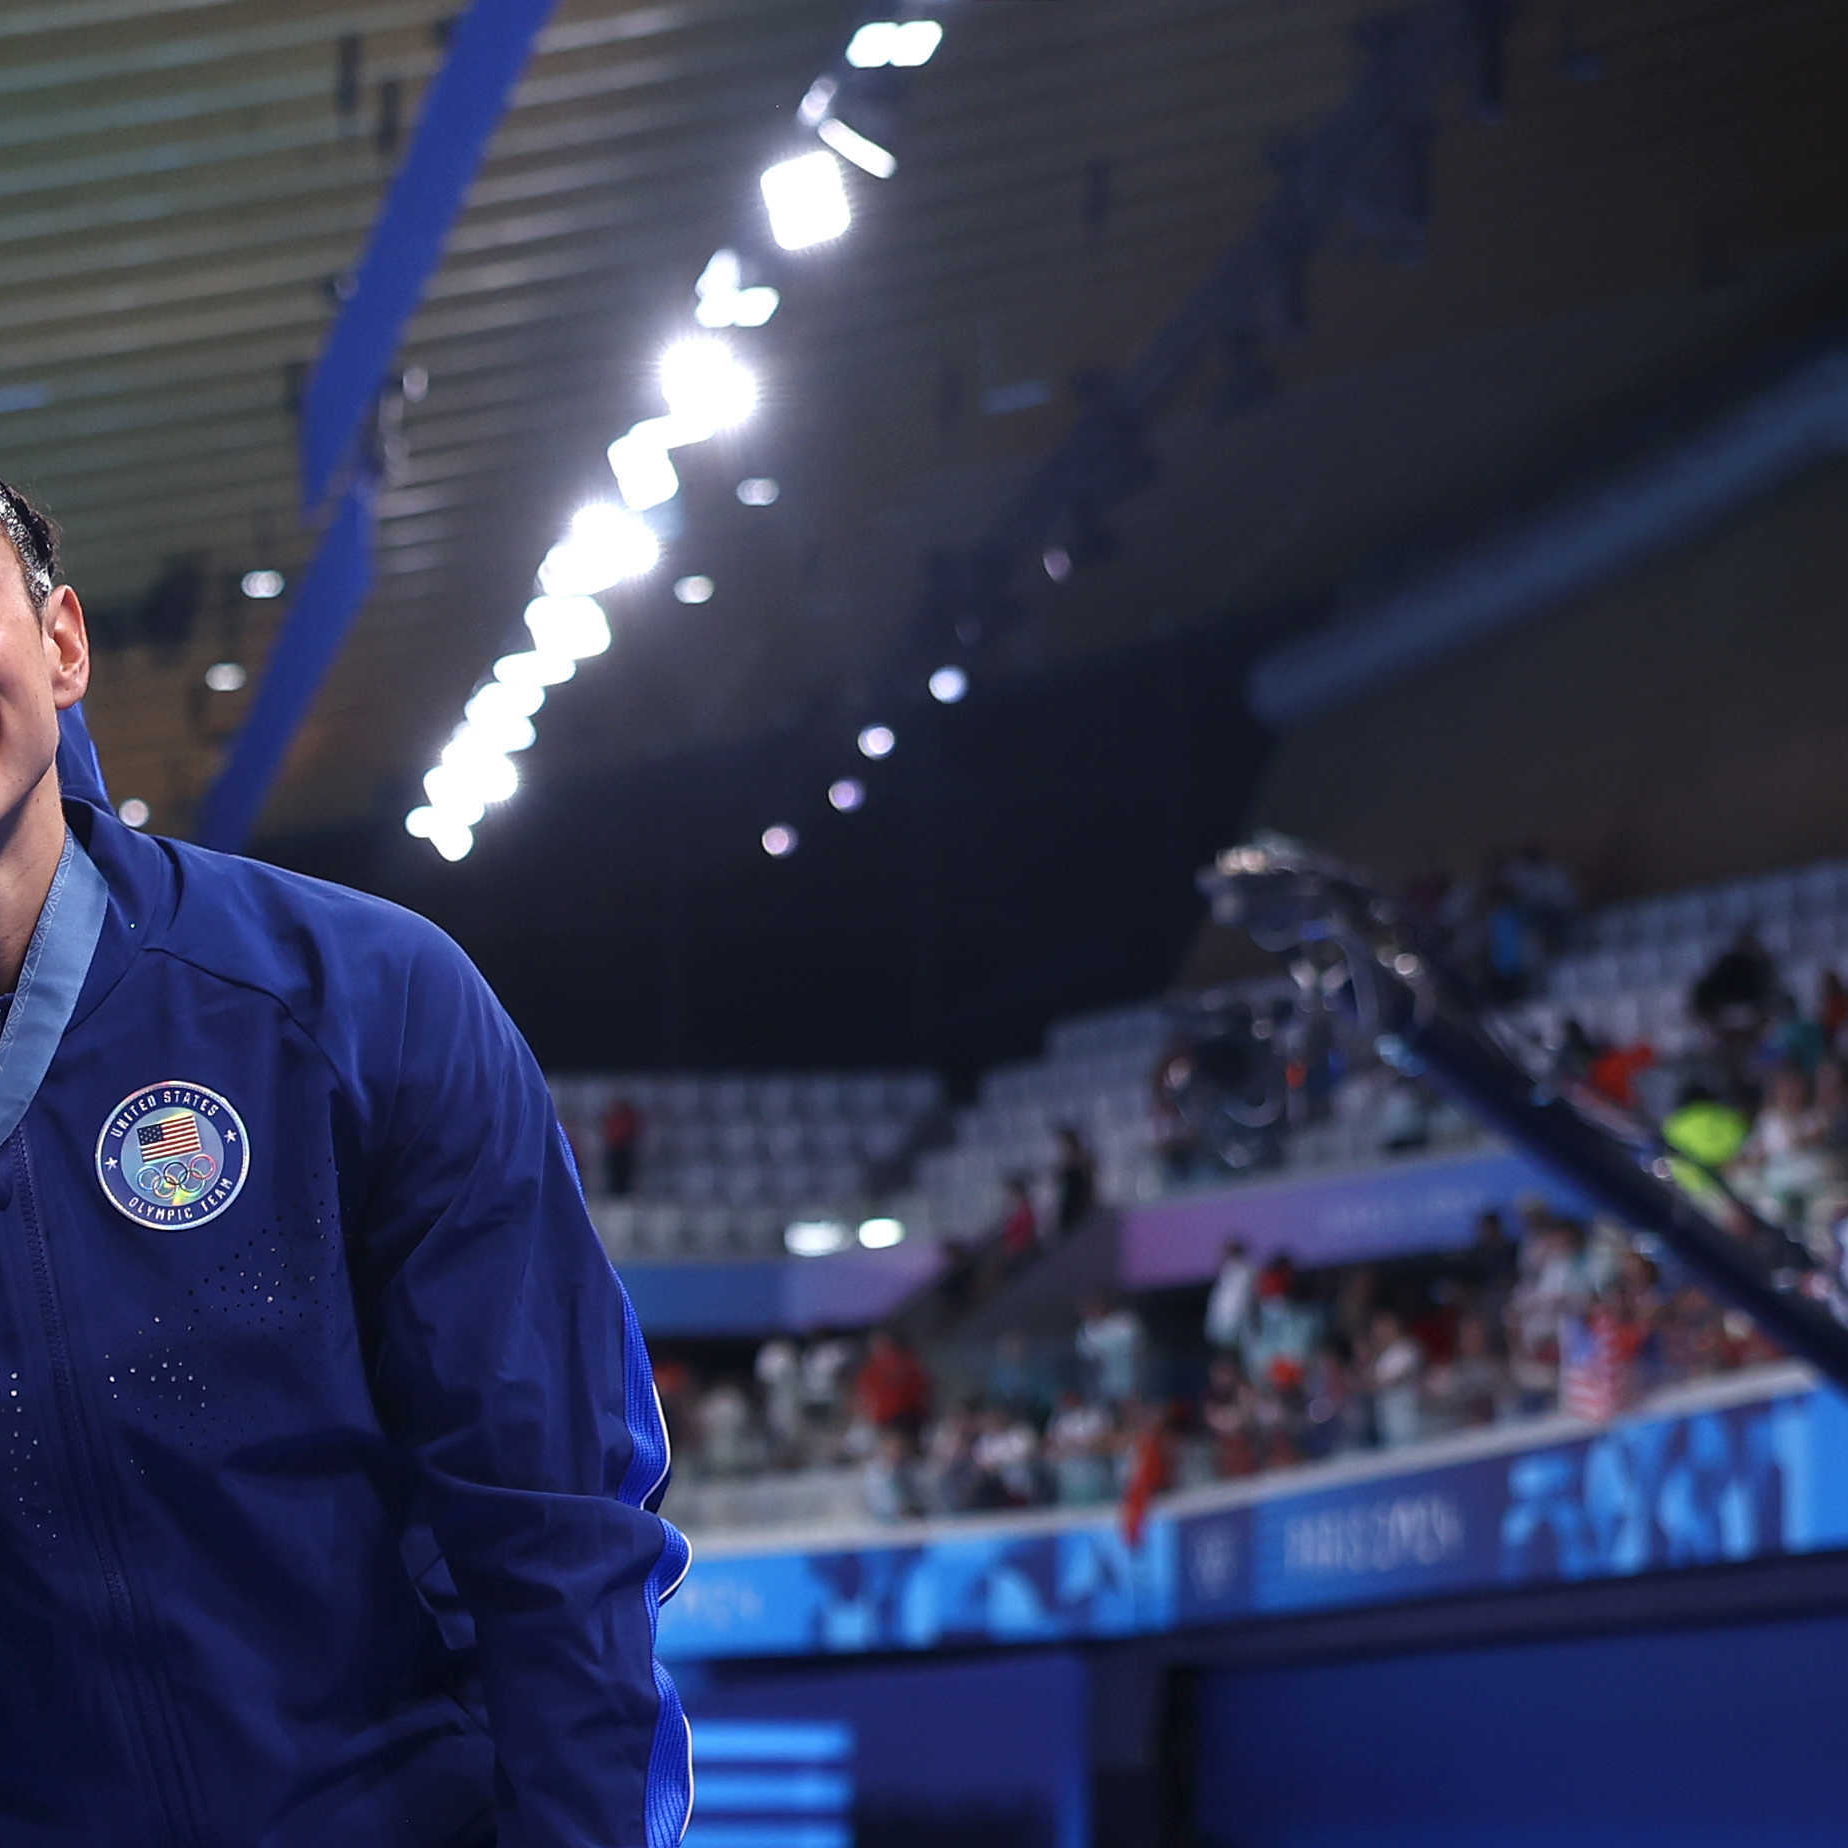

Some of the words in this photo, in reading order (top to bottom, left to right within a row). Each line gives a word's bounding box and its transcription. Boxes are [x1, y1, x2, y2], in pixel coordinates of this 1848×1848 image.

[110, 1094, 157, 1138] UNITED
[163, 1091, 220, 1117] STATES
[129, 1196, 193, 1221] OLYMPIC
[200, 1178, 233, 1212] TEAM
